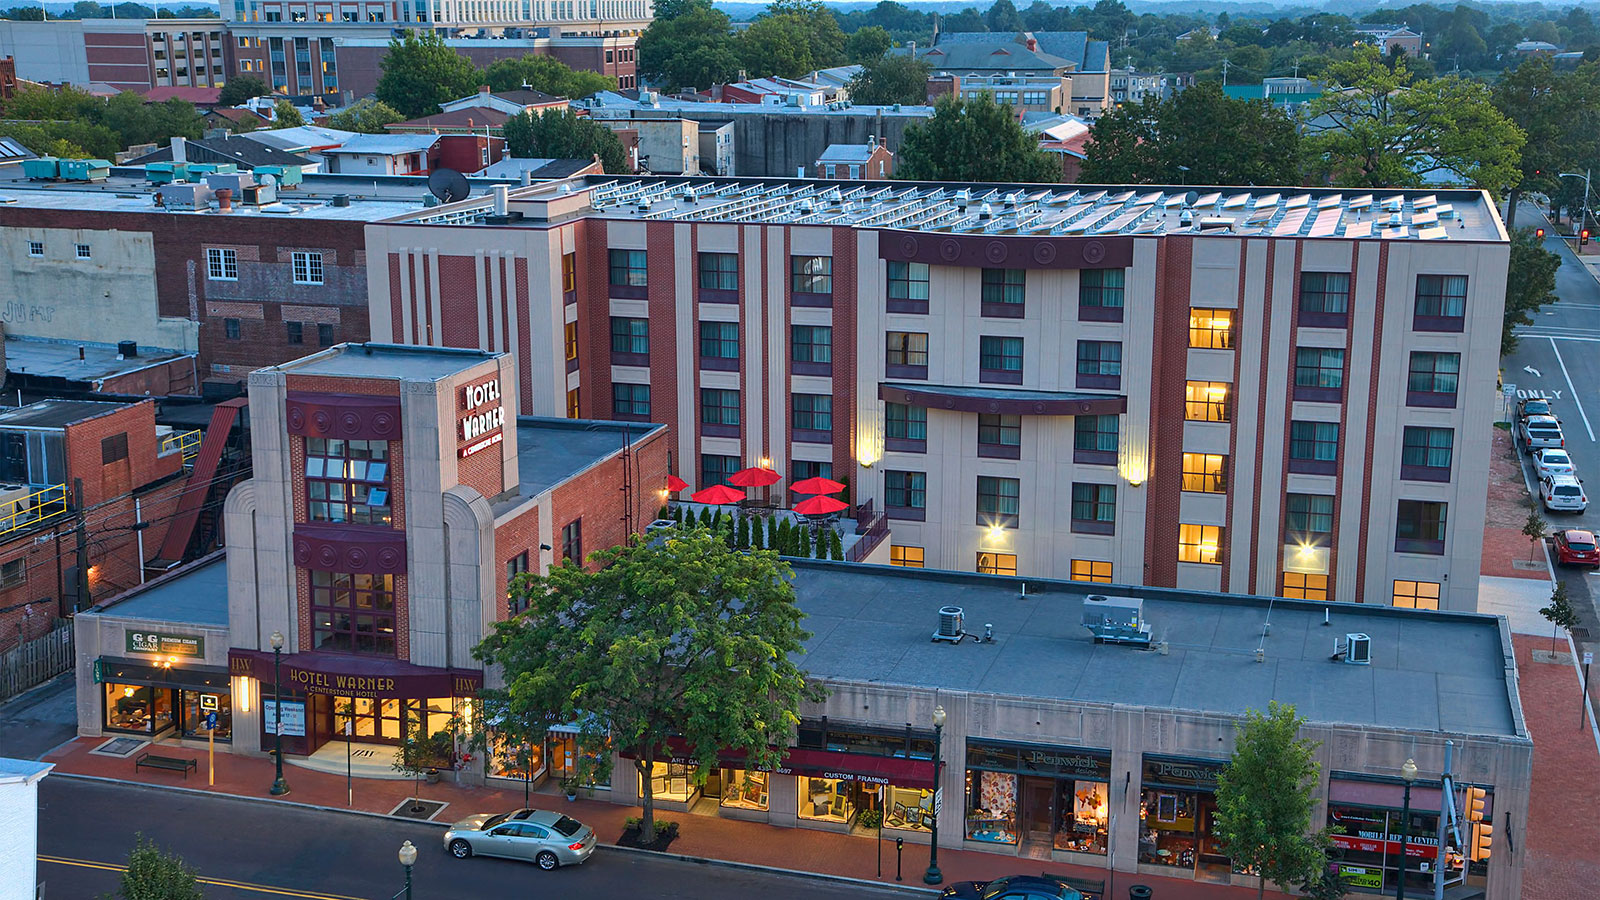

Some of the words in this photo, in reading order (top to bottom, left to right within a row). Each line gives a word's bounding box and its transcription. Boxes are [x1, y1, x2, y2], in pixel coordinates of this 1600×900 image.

[466, 380, 500, 410] HOTEL
[1516, 389, 1562, 400] ONLY
[463, 406, 505, 441] WARNER
[132, 642, 158, 650] CIGAR
[290, 669, 330, 687] HOTEL
[336, 675, 395, 691] WARNER
[310, 685, 354, 697] CENTERSTONE
[355, 690, 378, 698] HOTEL
[824, 772, 854, 780] CUSTOM
[857, 775, 890, 785] FRAMING
[1358, 830, 1385, 840] MOBILE
[1389, 833, 1413, 843] REPIR
[1414, 836, 1439, 845] CENTER
